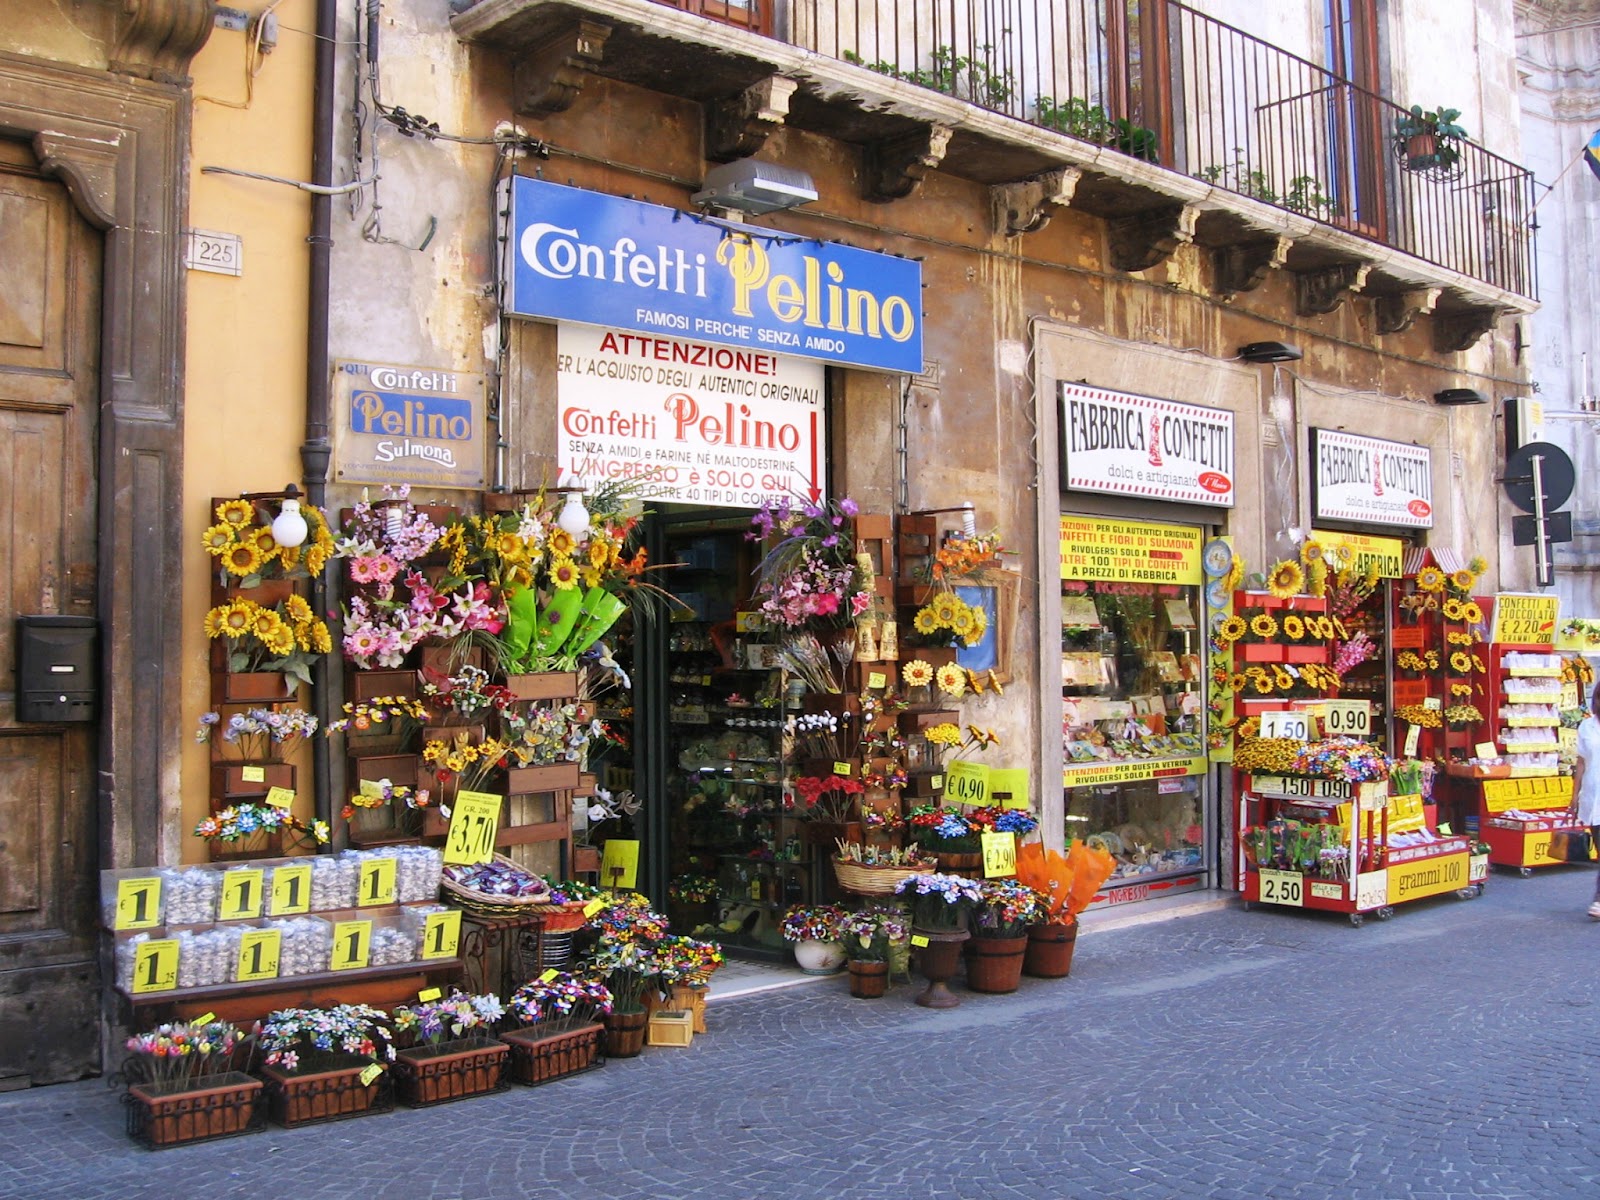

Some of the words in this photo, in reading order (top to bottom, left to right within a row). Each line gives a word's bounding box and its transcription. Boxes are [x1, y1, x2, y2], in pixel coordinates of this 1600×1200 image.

[200, 241, 232, 263] 225
[520, 222, 707, 298] Confetti
[716, 232, 915, 343] Pelino
[636, 308, 690, 330] FAMOSI
[695, 318, 753, 339] PERCHE'
[758, 328, 801, 347] SENZA
[805, 335, 845, 354] AMIDO
[599, 332, 777, 376] ATTENZIONE!
[345, 363, 368, 376] QUI
[370, 367, 458, 393] Confetti
[576, 356, 653, 383] L'ACQUISTO
[657, 367, 693, 389] DEGLI
[699, 374, 757, 397] AUTENTICI
[760, 382, 819, 405] ORIGINALI
[352, 391, 471, 440] Pelino
[563, 406, 656, 440] Confetti
[664, 392, 801, 453] Pelino
[1070, 400, 1146, 453] FABBRICA
[1163, 415, 1229, 474] CONFETTI
[374, 438, 457, 468] Sulmona
[569, 439, 605, 455] SENZA
[609, 444, 642, 458] AMIDI
[644, 450, 652, 459] e
[655, 449, 691, 463] FARINE
[714, 454, 795, 472] MALTODESTRINE
[571, 456, 679, 483] L'INGRESSO
[689, 466, 700, 485] è
[706, 469, 755, 489] SOLO
[761, 474, 792, 491] QUI
[1108, 463, 1134, 480] dolci
[1137, 471, 1144, 480] e
[1145, 469, 1198, 488] artigianato
[1320, 443, 1371, 487] FABBRICA
[1383, 453, 1429, 501] CONFETTI
[648, 485, 682, 499] OLTRE
[686, 488, 700, 501] 40
[704, 489, 722, 502] TIPI
[726, 491, 737, 503] DI
[1096, 524, 1111, 532] PER
[1112, 526, 1124, 534] GLI
[1126, 526, 1162, 537] AUTENTICI
[1164, 528, 1197, 540] ORIGINALI
[1100, 535, 1105, 543] E
[1109, 535, 1134, 546] FIORI
[1137, 537, 1147, 547] DI
[1150, 539, 1194, 550] SULMONA
[1071, 545, 1118, 555] RIVOLGERSI
[1120, 548, 1140, 557] SOLO
[1142, 549, 1147, 557] A
[1091, 556, 1109, 566] 100
[1113, 557, 1132, 567] TIPI
[1135, 559, 1144, 568] DI
[1147, 560, 1189, 571] CONFETTI
[1072, 566, 1078, 576] A
[1082, 567, 1115, 578] PREZZI
[1119, 568, 1129, 578] DI
[1131, 570, 1177, 581] FABBRICA
[1498, 609, 1555, 621] CIOCCOLATO
[1499, 597, 1540, 609] CONFETTI
[1546, 599, 1555, 609] AL
[1501, 621, 1508, 634] €
[1502, 634, 1531, 642] GRAMMI
[1536, 633, 1551, 644] 200
[1330, 709, 1367, 733] 0,90
[1062, 767, 1113, 777] ATTENZIONE!
[1132, 763, 1160, 771] QUESTA
[1162, 759, 1192, 768] VETRINA
[1075, 774, 1122, 785] RIVOLGERSI
[1124, 771, 1144, 780] SOLO
[958, 776, 984, 802] 0,90
[464, 804, 477, 813] GR.
[456, 814, 494, 862] 3,70
[1265, 879, 1301, 903] 2,50
[1399, 864, 1441, 896] grammi
[1444, 861, 1461, 883] 100
[232, 880, 254, 913] 1
[282, 875, 304, 909] 1
[1108, 885, 1149, 905] INGRESSO
[128, 888, 152, 923] 1
[341, 930, 363, 964] 1
